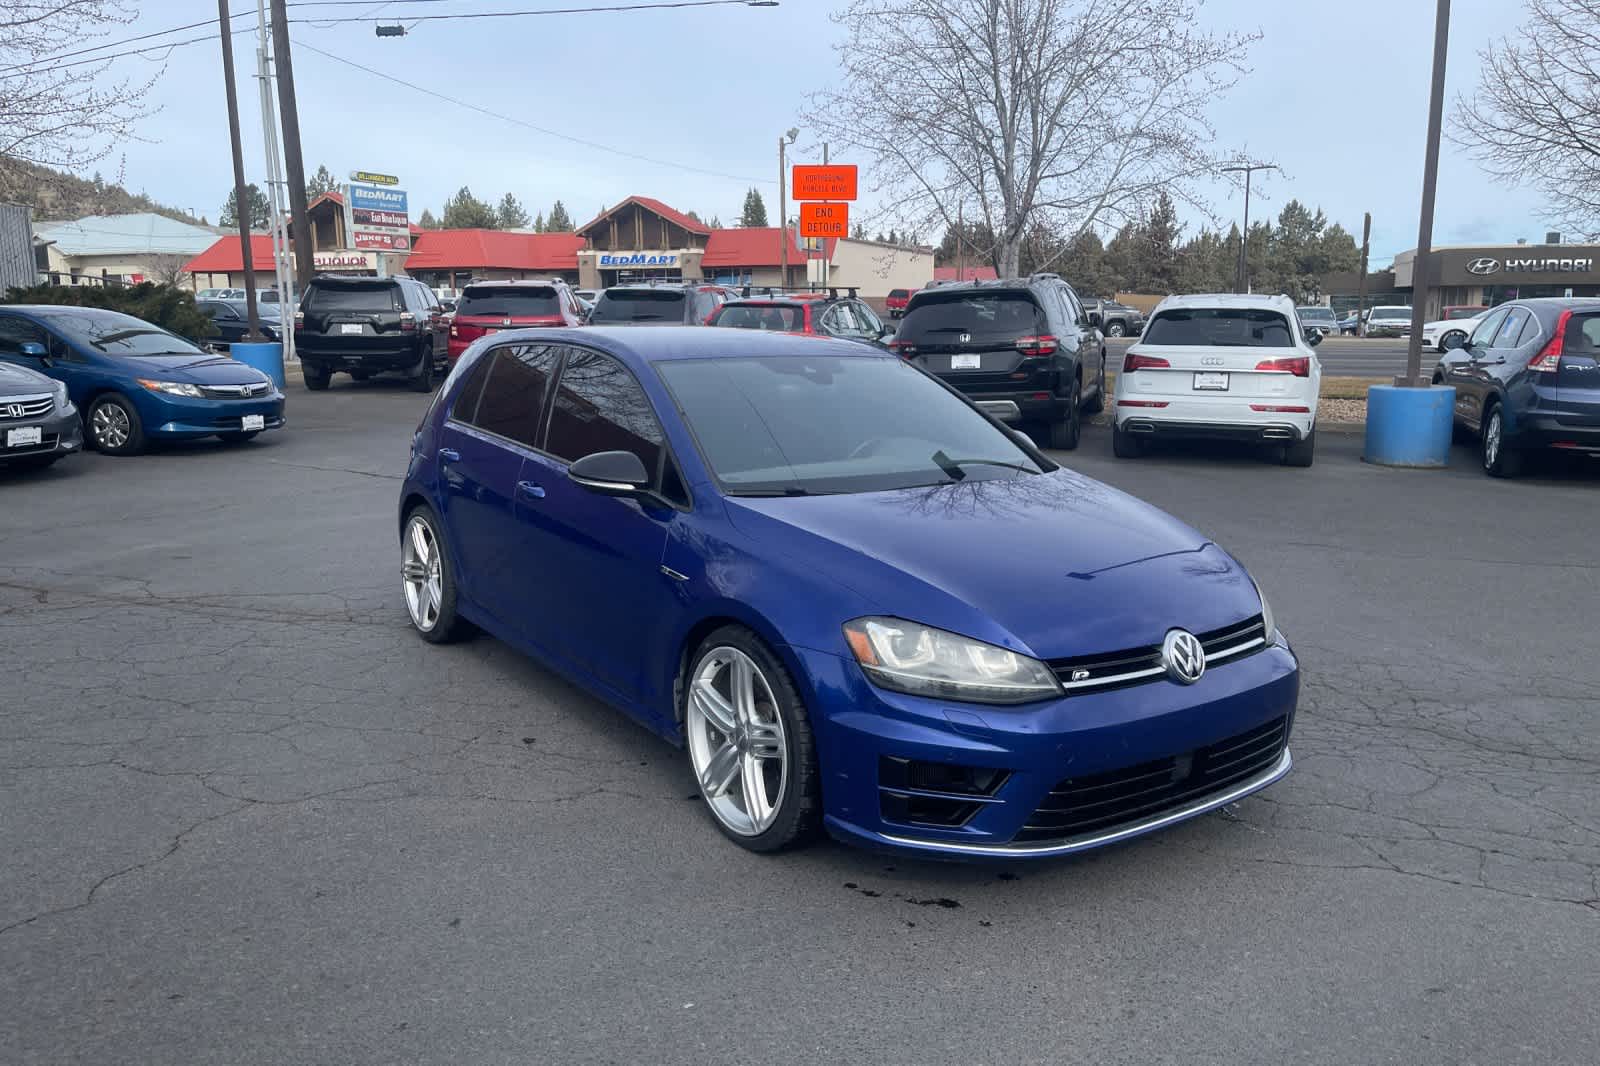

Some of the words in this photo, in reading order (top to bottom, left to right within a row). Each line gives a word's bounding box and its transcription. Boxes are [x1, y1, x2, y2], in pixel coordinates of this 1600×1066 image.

[815, 207, 833, 218] END
[807, 222, 842, 233] DETOUR
[322, 256, 367, 267] LIQUOR
[1505, 258, 1593, 273] HYUNDAI
